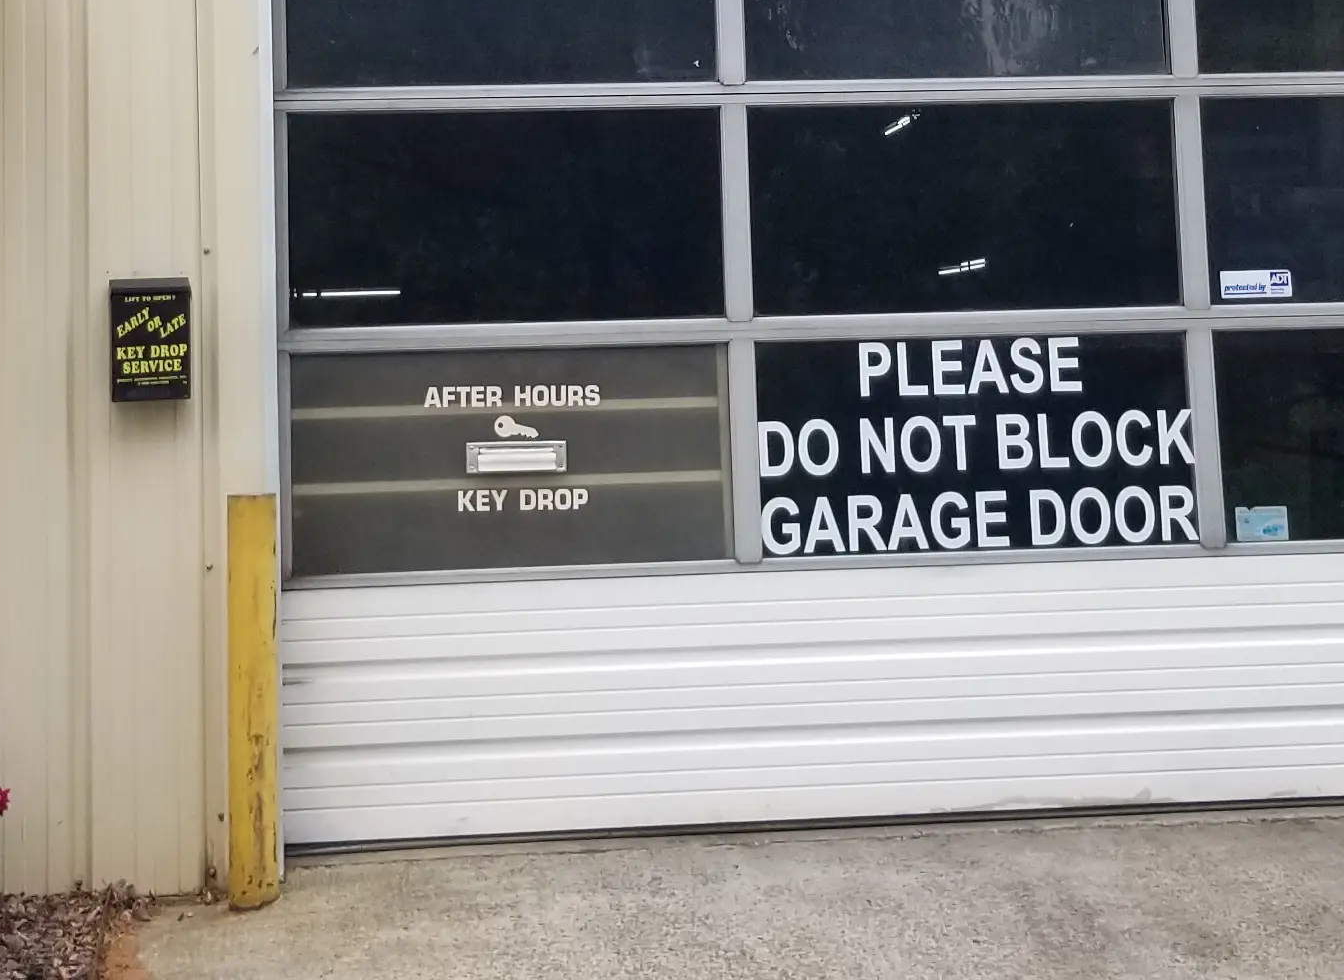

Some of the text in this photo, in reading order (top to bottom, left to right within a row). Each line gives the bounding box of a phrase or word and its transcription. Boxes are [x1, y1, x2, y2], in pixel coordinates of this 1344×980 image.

[1224, 283, 1257, 292] protected
[1258, 282, 1267, 292] by
[1270, 272, 1289, 285] ADT
[116, 306, 187, 339] EARLY OR LATE
[116, 343, 188, 360] KEY DROP
[122, 358, 183, 375] SERVICE
[858, 336, 1083, 397] PLEASE
[423, 384, 601, 408] AFTER HOURS
[757, 408, 1196, 477] DO NOT BLOCK
[457, 488, 589, 512] KEY DROP
[760, 485, 1200, 556] GARAGE DOOR
